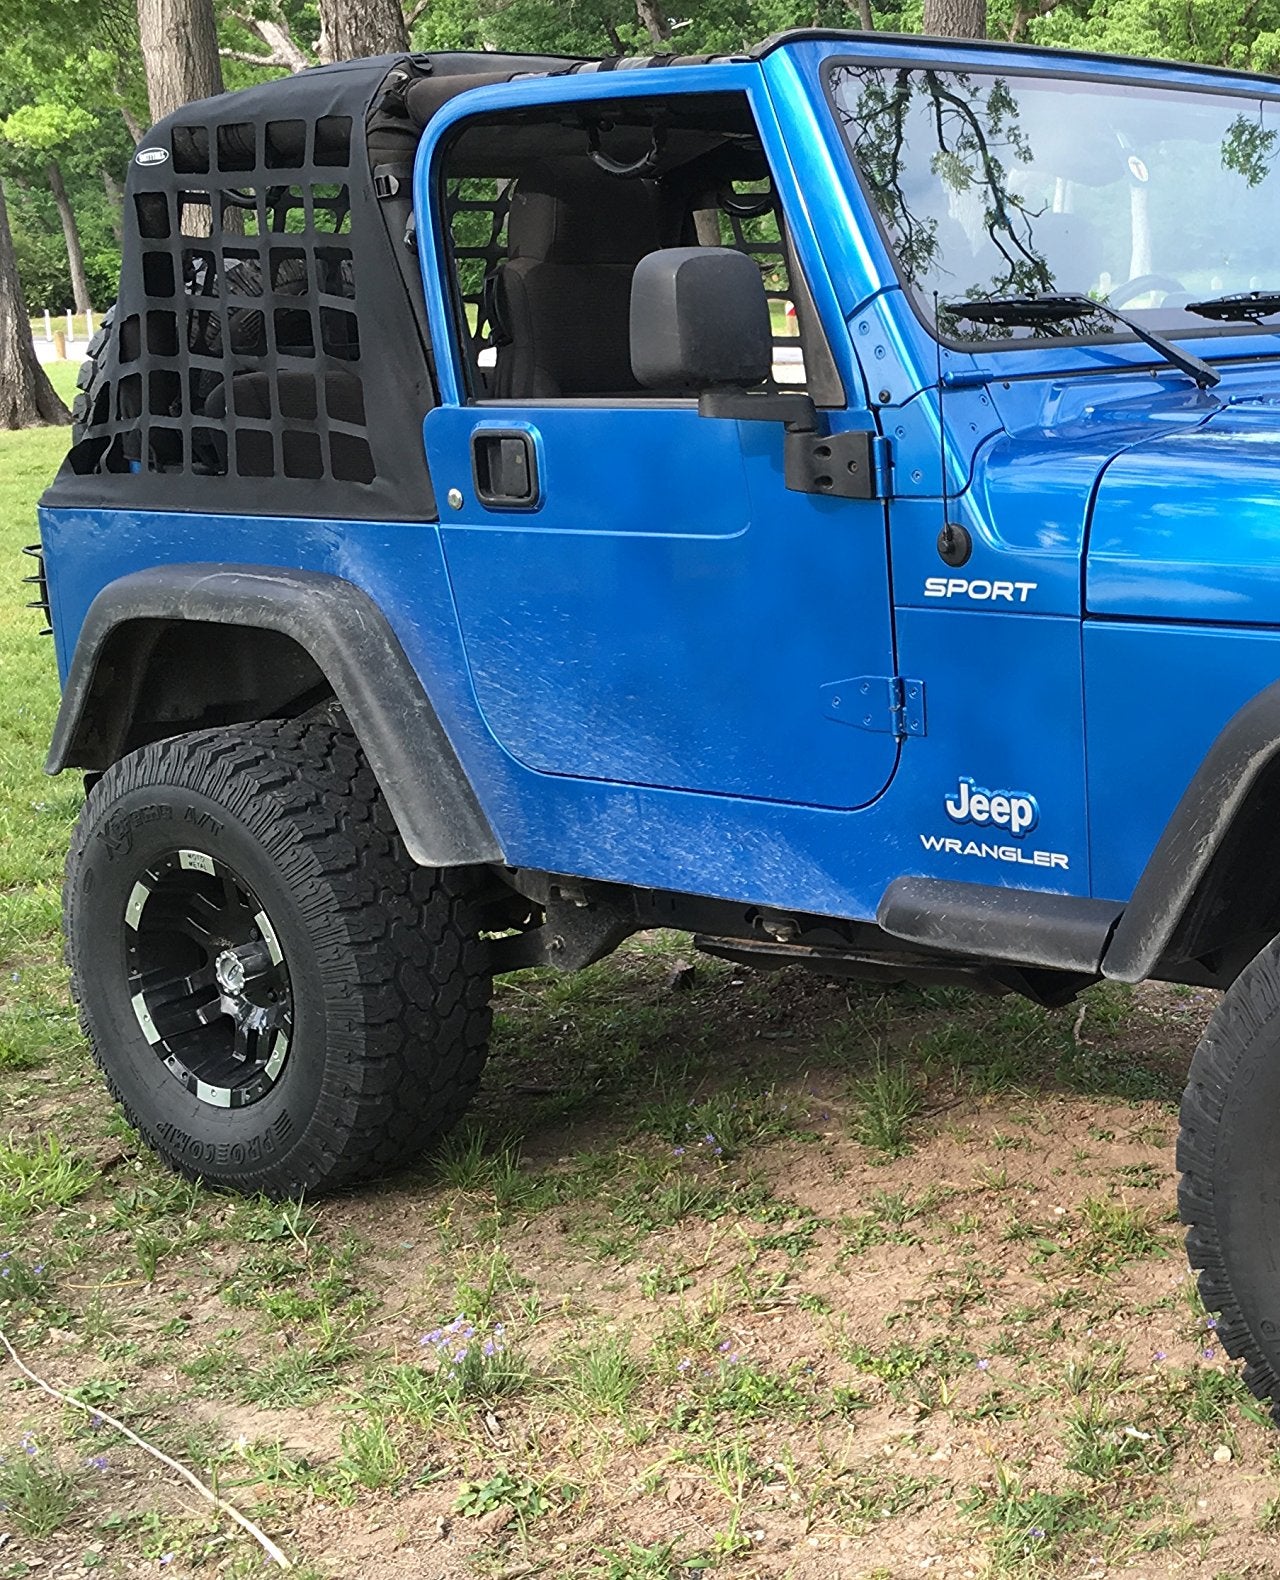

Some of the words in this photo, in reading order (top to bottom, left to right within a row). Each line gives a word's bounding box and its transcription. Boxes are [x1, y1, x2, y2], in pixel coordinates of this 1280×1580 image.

[923, 577, 1038, 602] SPORT
[945, 781, 1035, 834] Jeep
[920, 834, 1069, 870] WRANGLER
